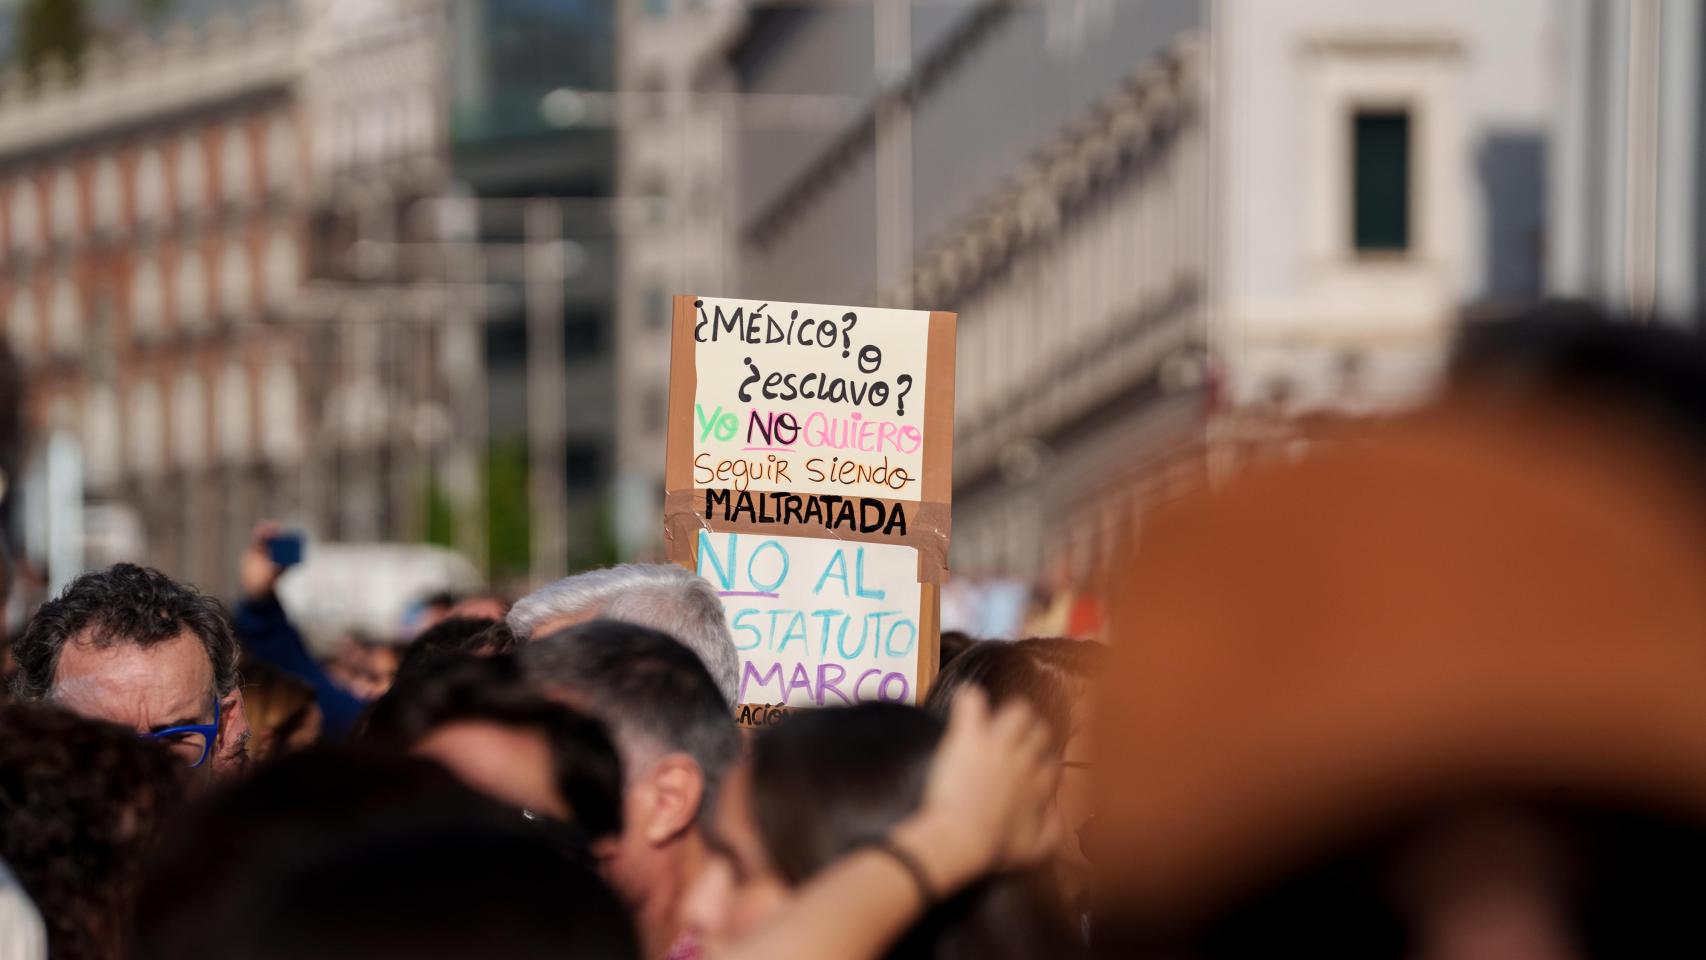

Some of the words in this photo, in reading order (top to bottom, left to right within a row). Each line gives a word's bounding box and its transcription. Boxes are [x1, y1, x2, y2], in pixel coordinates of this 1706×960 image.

[738, 356, 913, 417] ¿esclavo?
[747, 409, 802, 446] NO
[704, 488, 907, 537] MALTRATADA
[697, 530, 790, 593] NO
[812, 546, 886, 600] AL
[724, 607, 917, 661] STATUTO
[739, 660, 910, 706] MARCO
